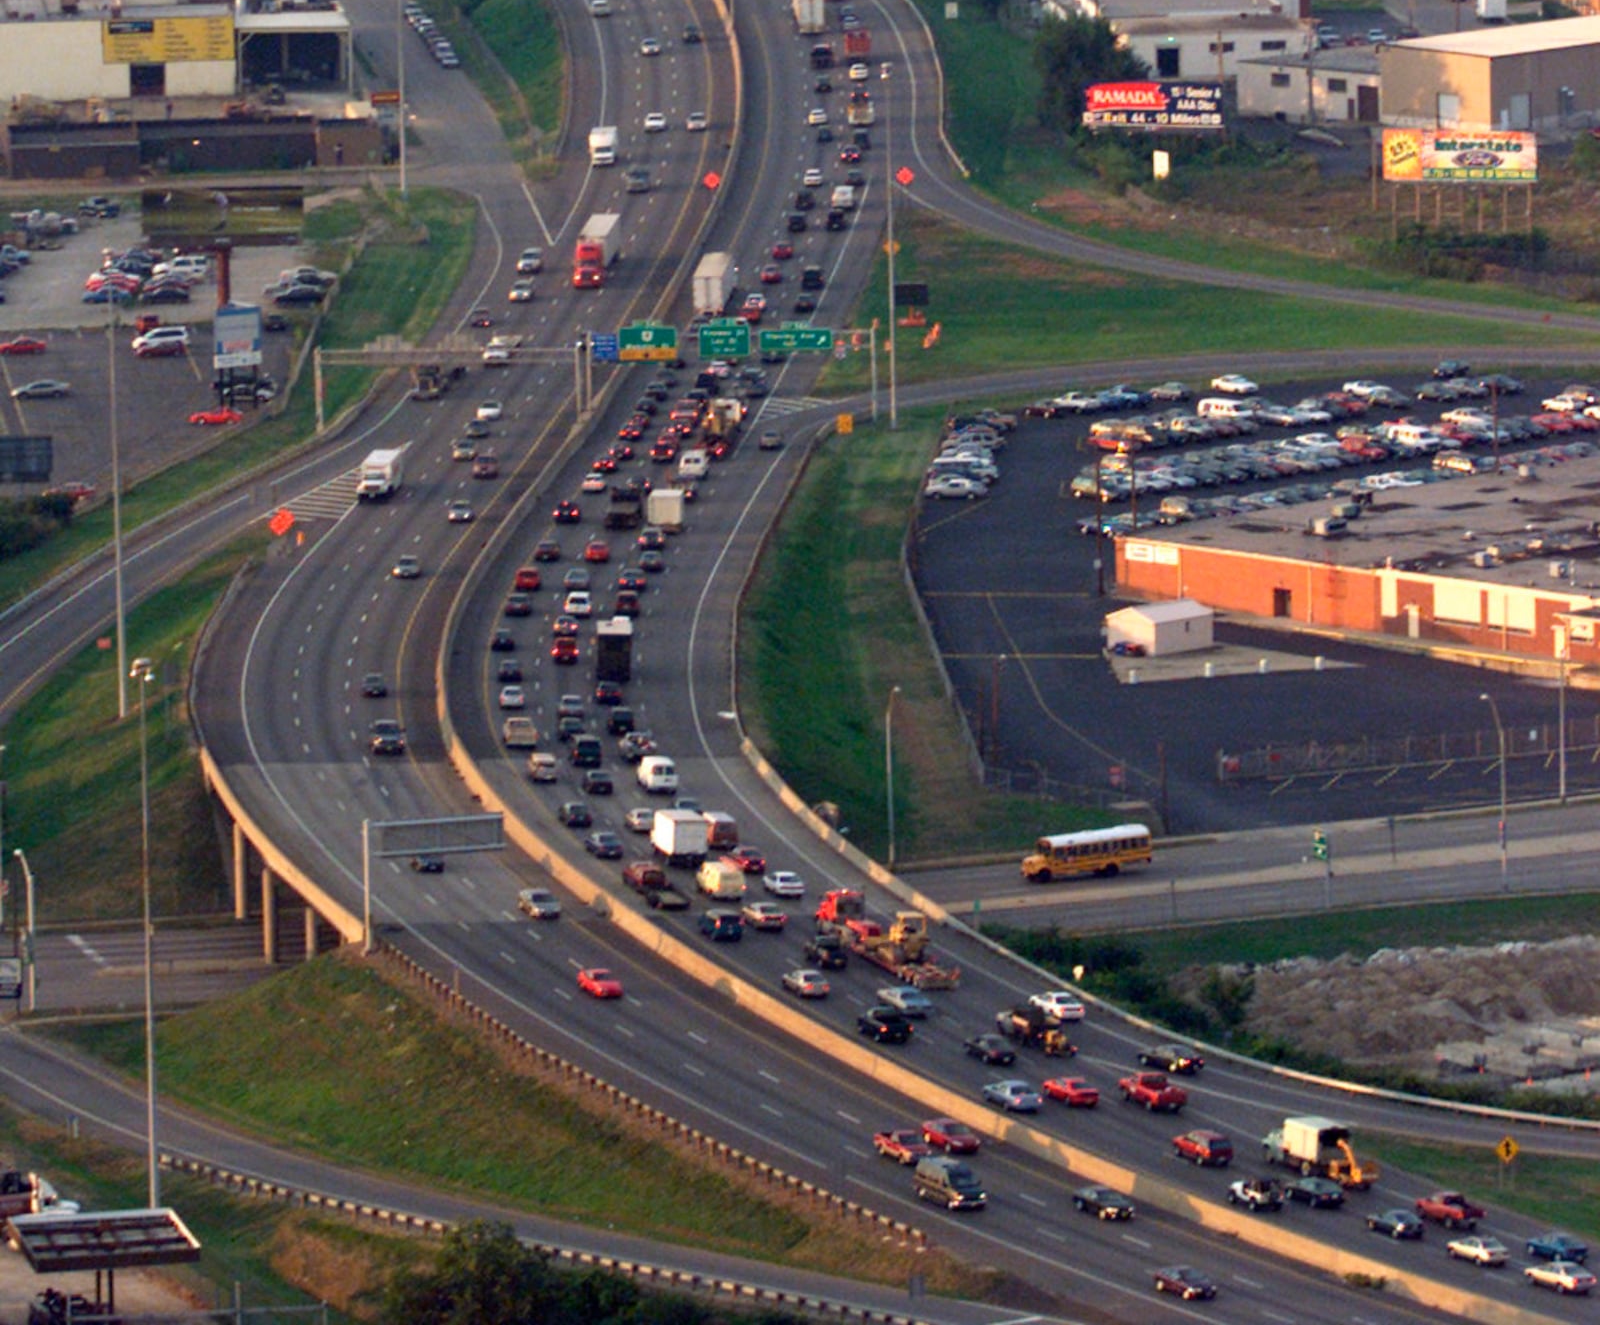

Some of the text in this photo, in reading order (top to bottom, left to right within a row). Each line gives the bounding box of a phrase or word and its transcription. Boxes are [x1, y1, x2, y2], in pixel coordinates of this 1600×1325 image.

[1093, 90, 1156, 104] RAMADA
[1177, 99, 1196, 110] AAA
[1130, 112, 1145, 123] 44
[1434, 139, 1523, 152] Interstate
